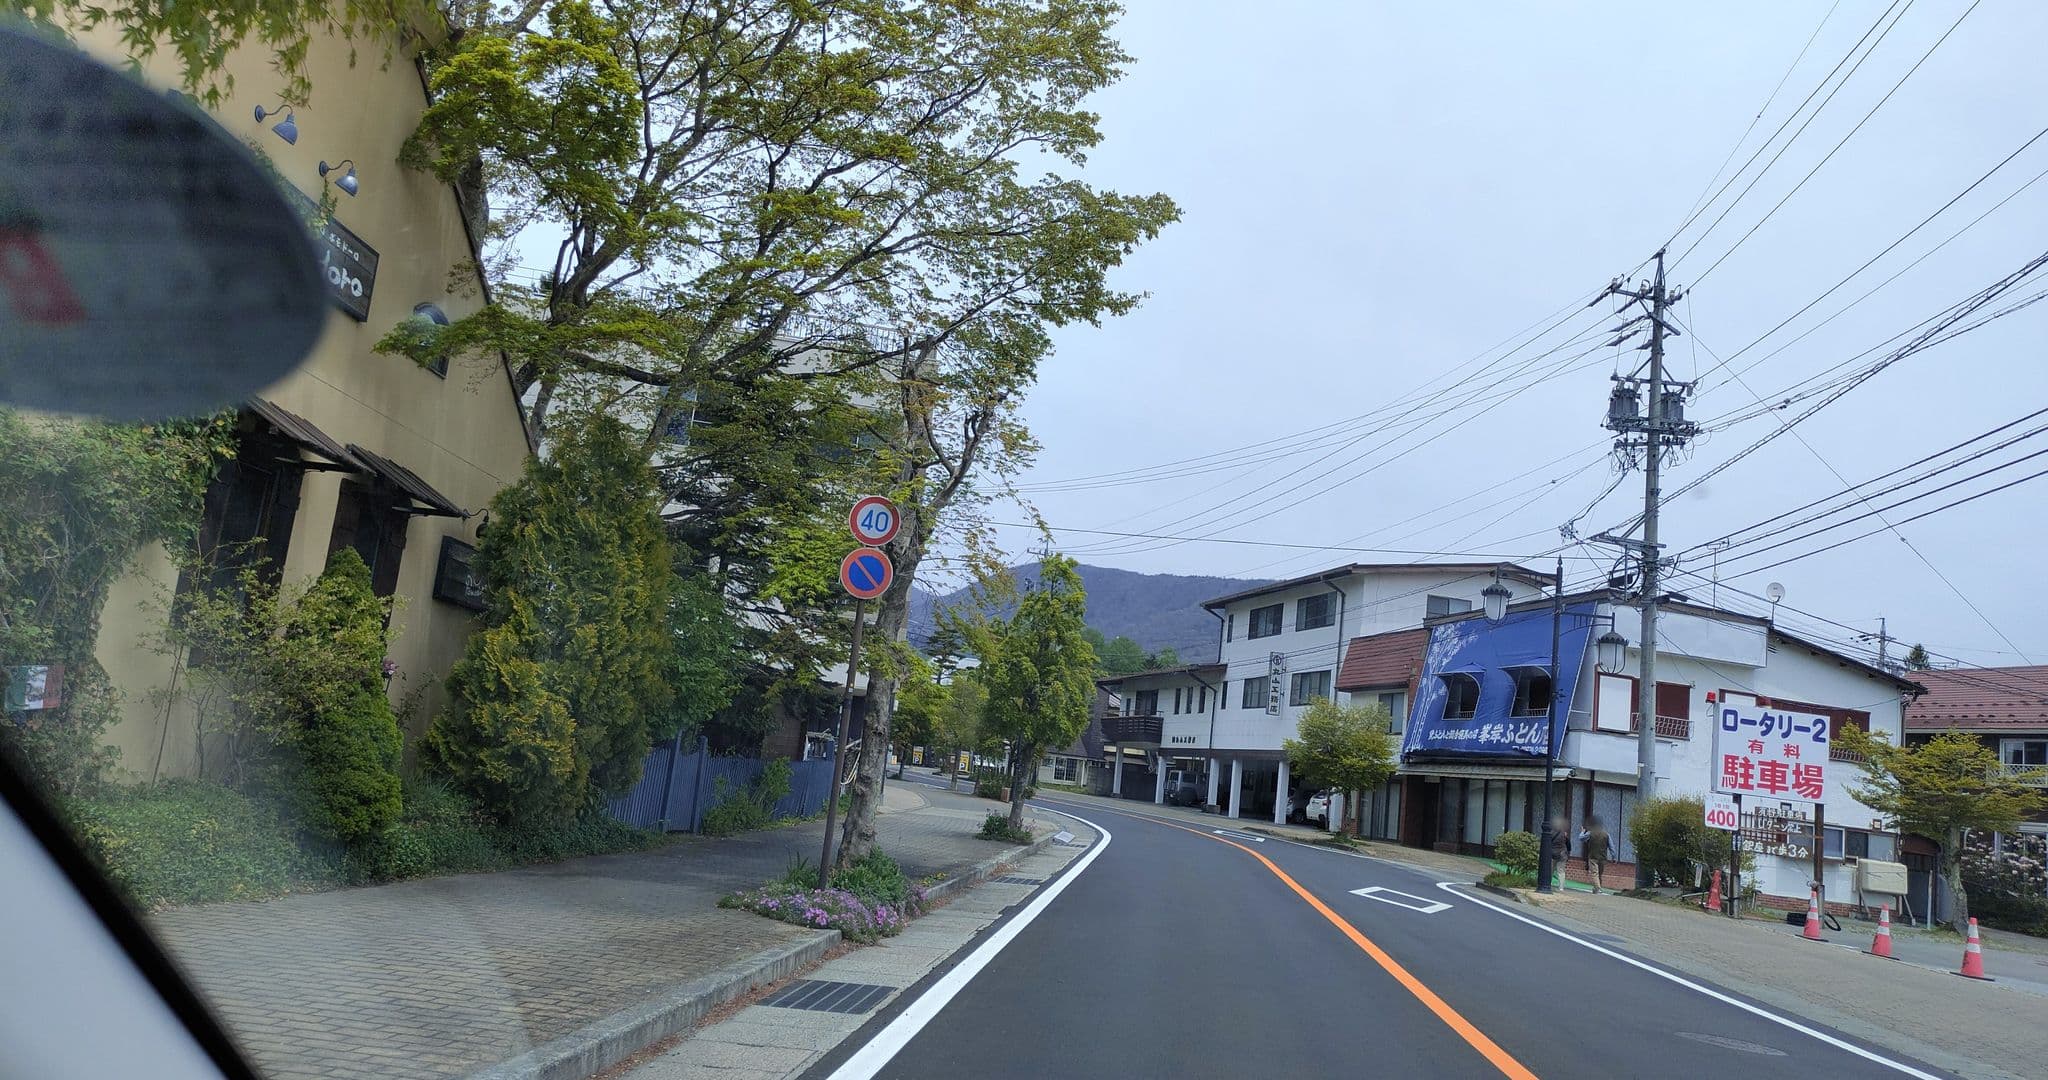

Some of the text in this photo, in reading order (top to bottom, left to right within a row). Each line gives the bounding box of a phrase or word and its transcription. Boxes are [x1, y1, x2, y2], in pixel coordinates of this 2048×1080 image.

[860, 509, 889, 533] 40
[1722, 708, 1827, 744] ロータリー2
[1721, 754, 1825, 800] 駐車場
[1706, 809, 1736, 828] 400
